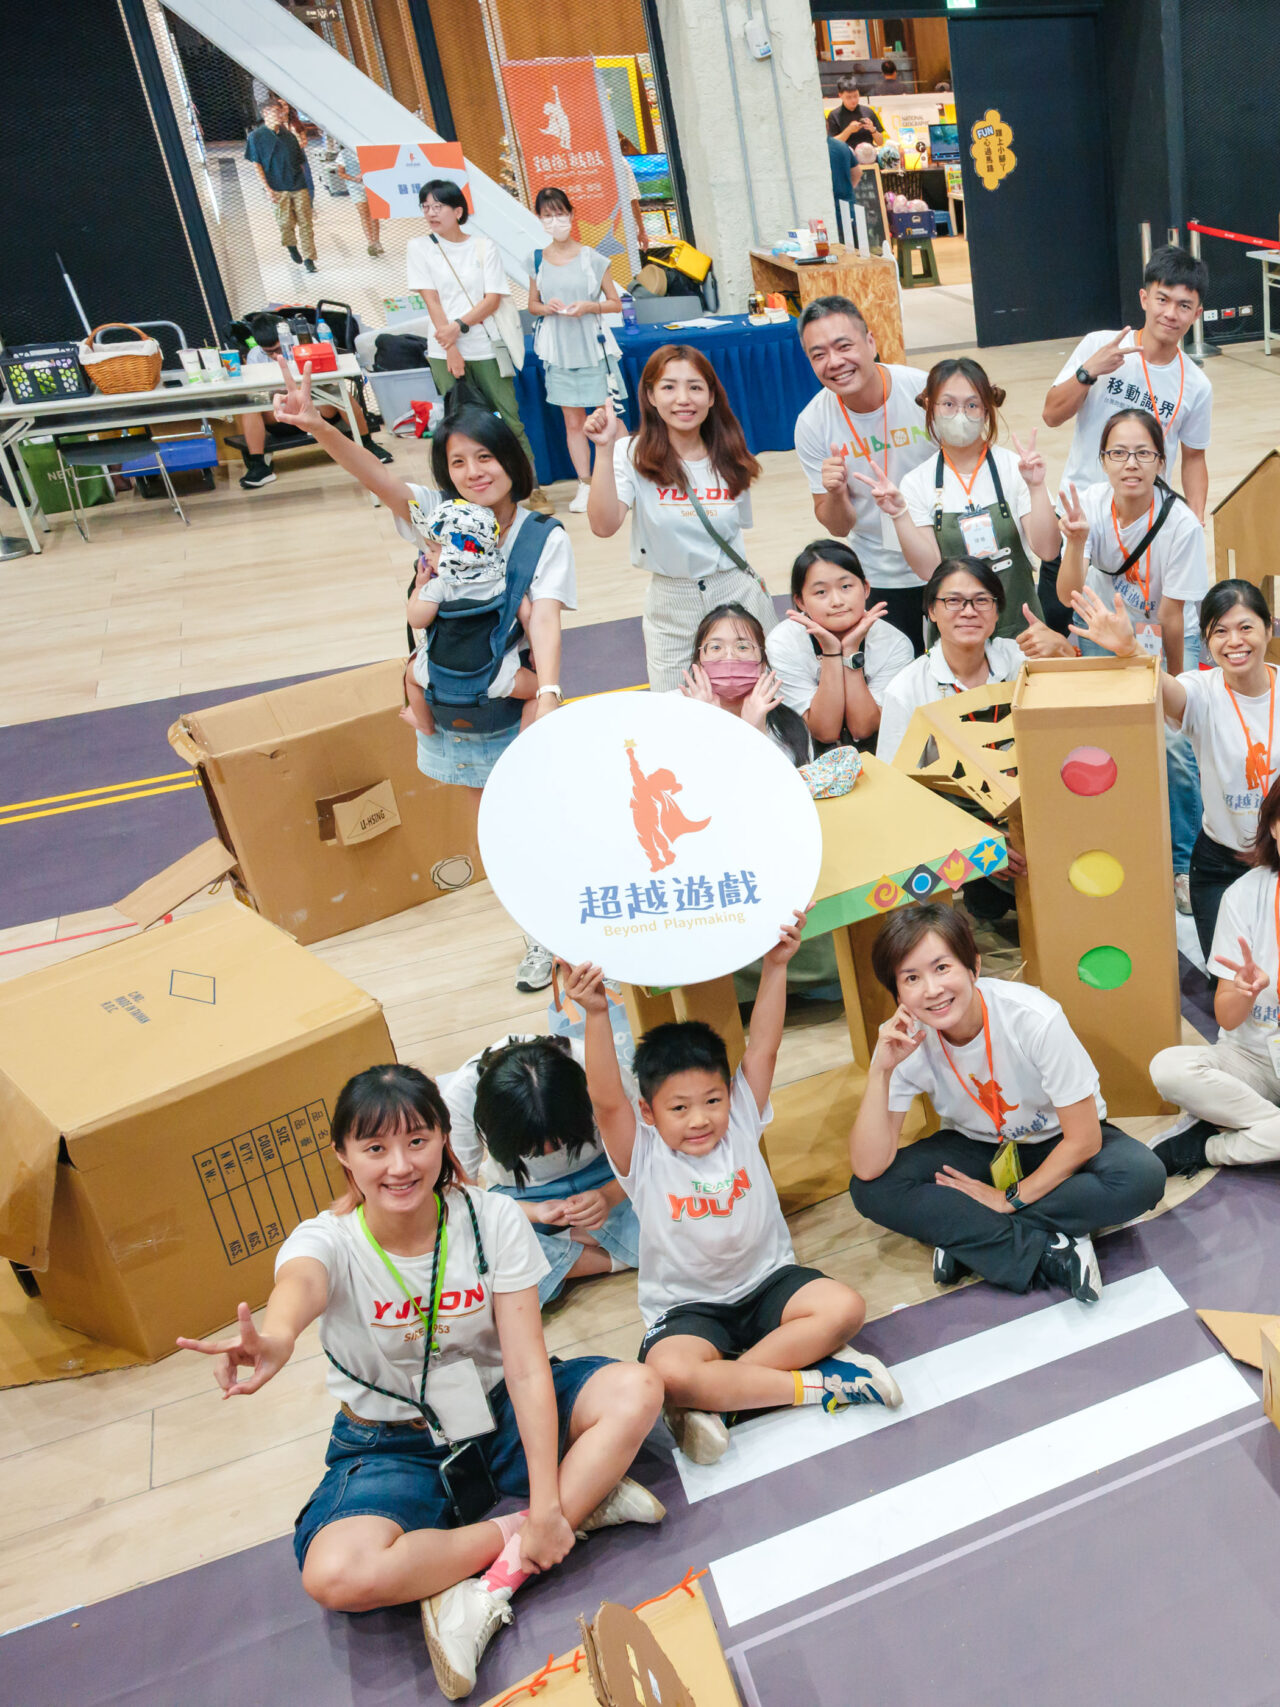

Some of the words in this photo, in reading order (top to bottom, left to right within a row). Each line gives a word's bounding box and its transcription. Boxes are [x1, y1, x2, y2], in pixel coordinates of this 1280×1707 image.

[976, 125, 994, 139] FUN
[1106, 376, 1175, 419] 移動識界
[579, 869, 762, 925] 超越遊戲
[603, 920, 657, 938] Beyond
[663, 911, 746, 931] Playmaking
[257, 1134, 275, 1162] COLOR
[276, 1125, 291, 1146] SIZE
